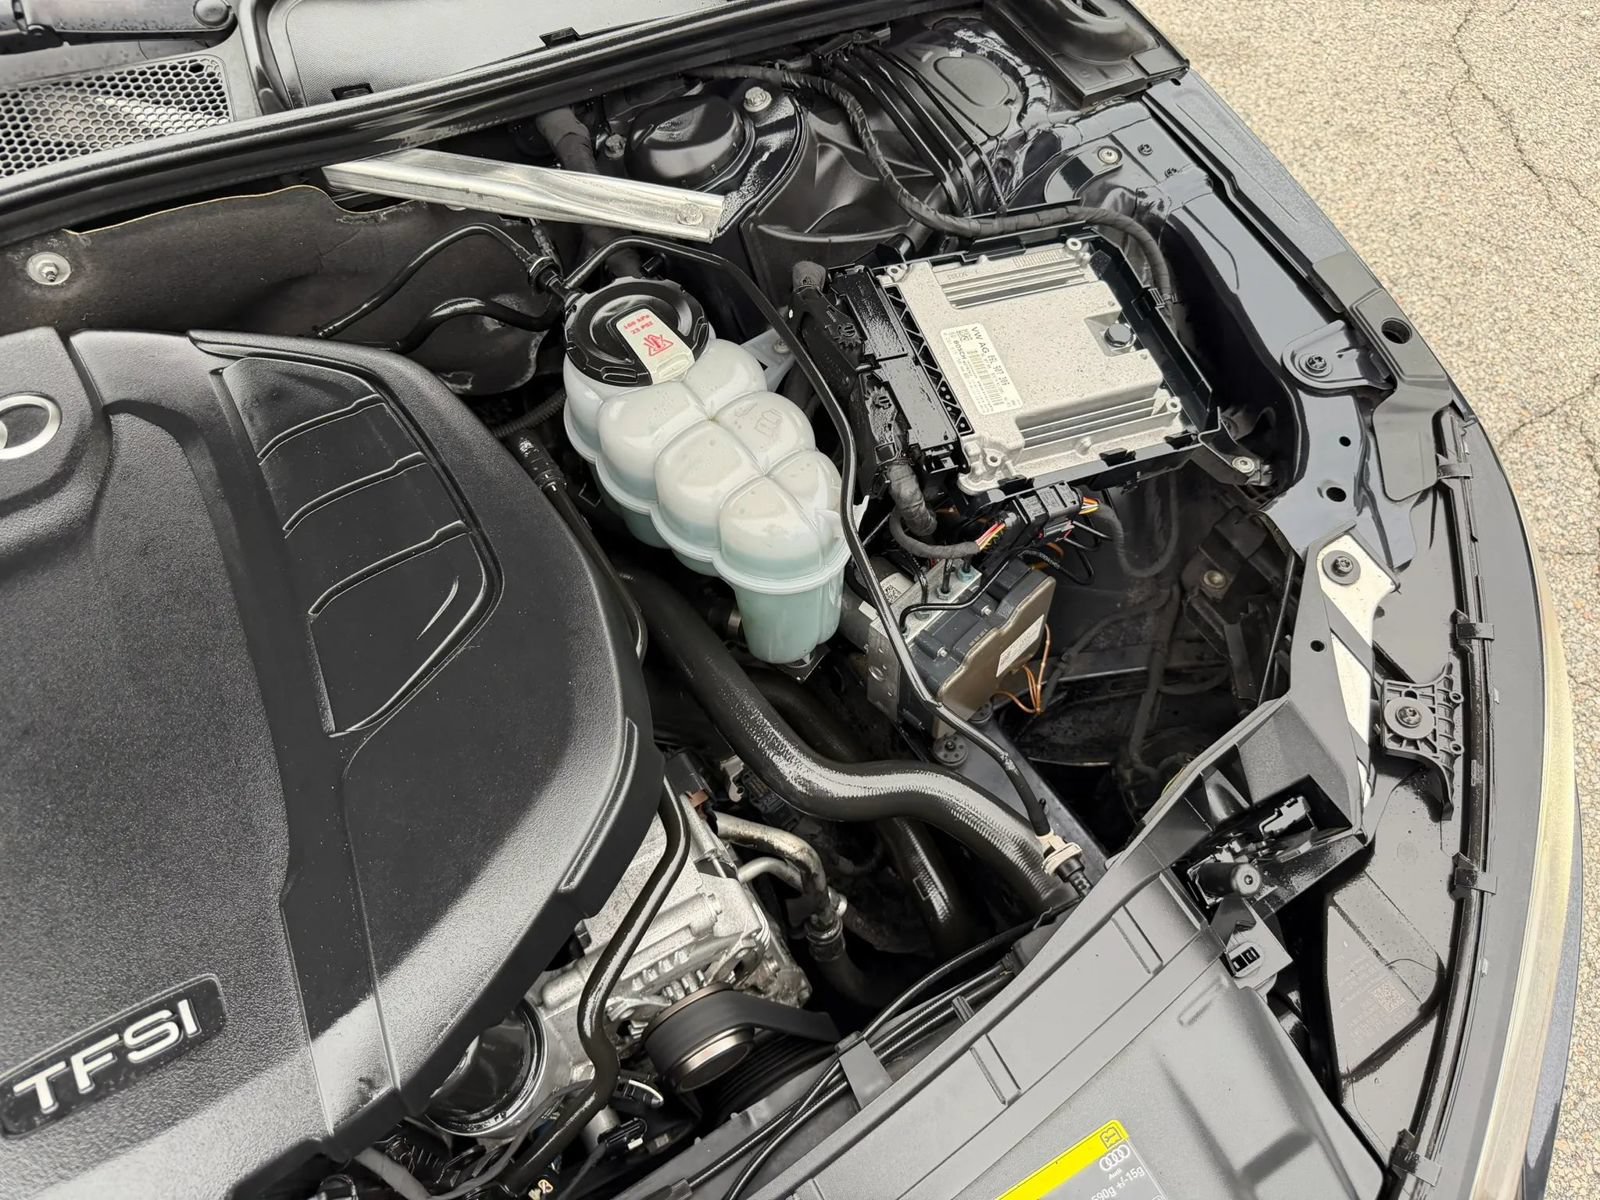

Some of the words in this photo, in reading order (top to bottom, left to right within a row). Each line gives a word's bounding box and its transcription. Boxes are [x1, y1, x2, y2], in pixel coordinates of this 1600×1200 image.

[641, 321, 653, 329] PSI
[953, 340, 966, 359] BOSCH
[971, 326, 983, 340] VW
[979, 341, 990, 354] AG
[13, 999, 202, 1114] TFSI
[1108, 1168, 1122, 1181] Audi
